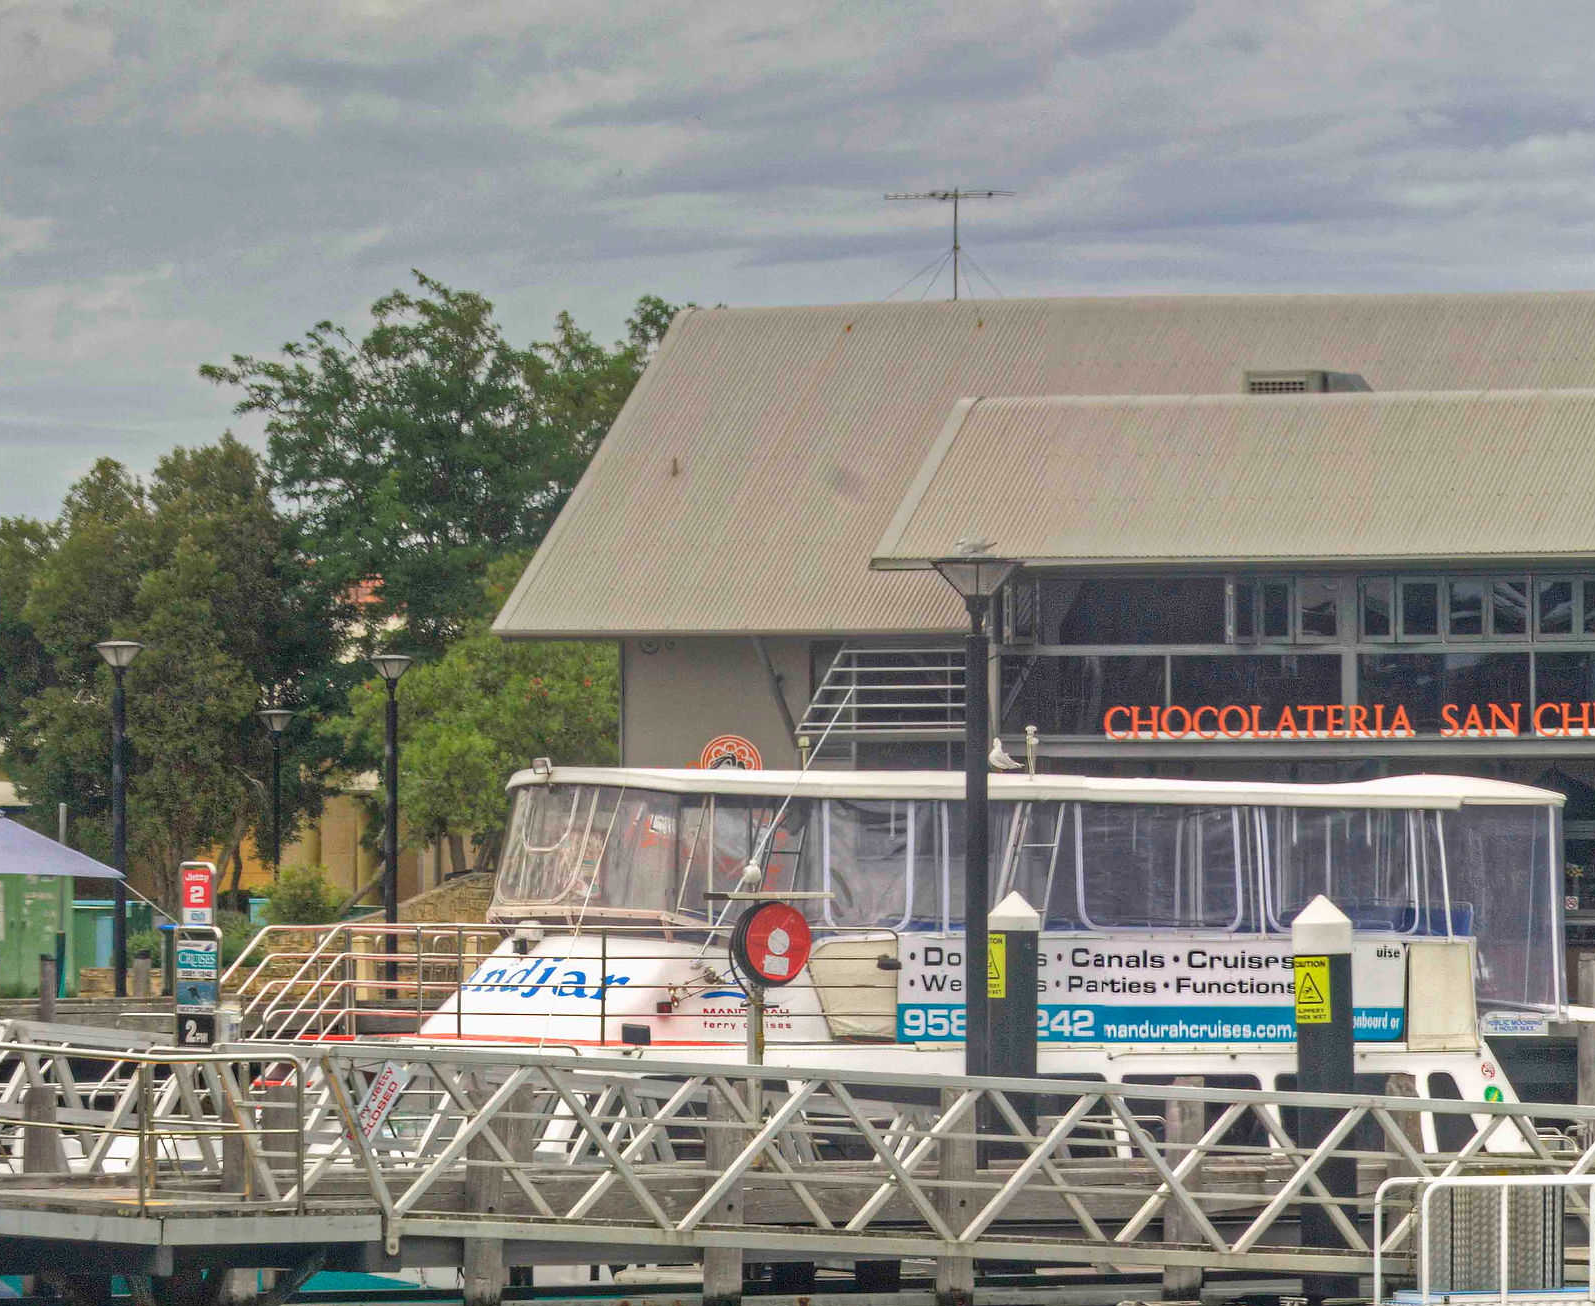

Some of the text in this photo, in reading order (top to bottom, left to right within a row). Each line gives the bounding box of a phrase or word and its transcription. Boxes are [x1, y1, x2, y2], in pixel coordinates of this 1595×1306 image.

[1103, 704, 1416, 740] CHOCOLATERIA
[1440, 703, 1521, 738] SAN
[190, 885, 205, 904] 2
[1071, 948, 1295, 969] Canals Cruises
[1068, 975, 1296, 994] Parties Functions
[704, 1021, 792, 1030] ferry cises
[903, 1008, 966, 1037] 958
[1037, 1009, 1095, 1037] 242
